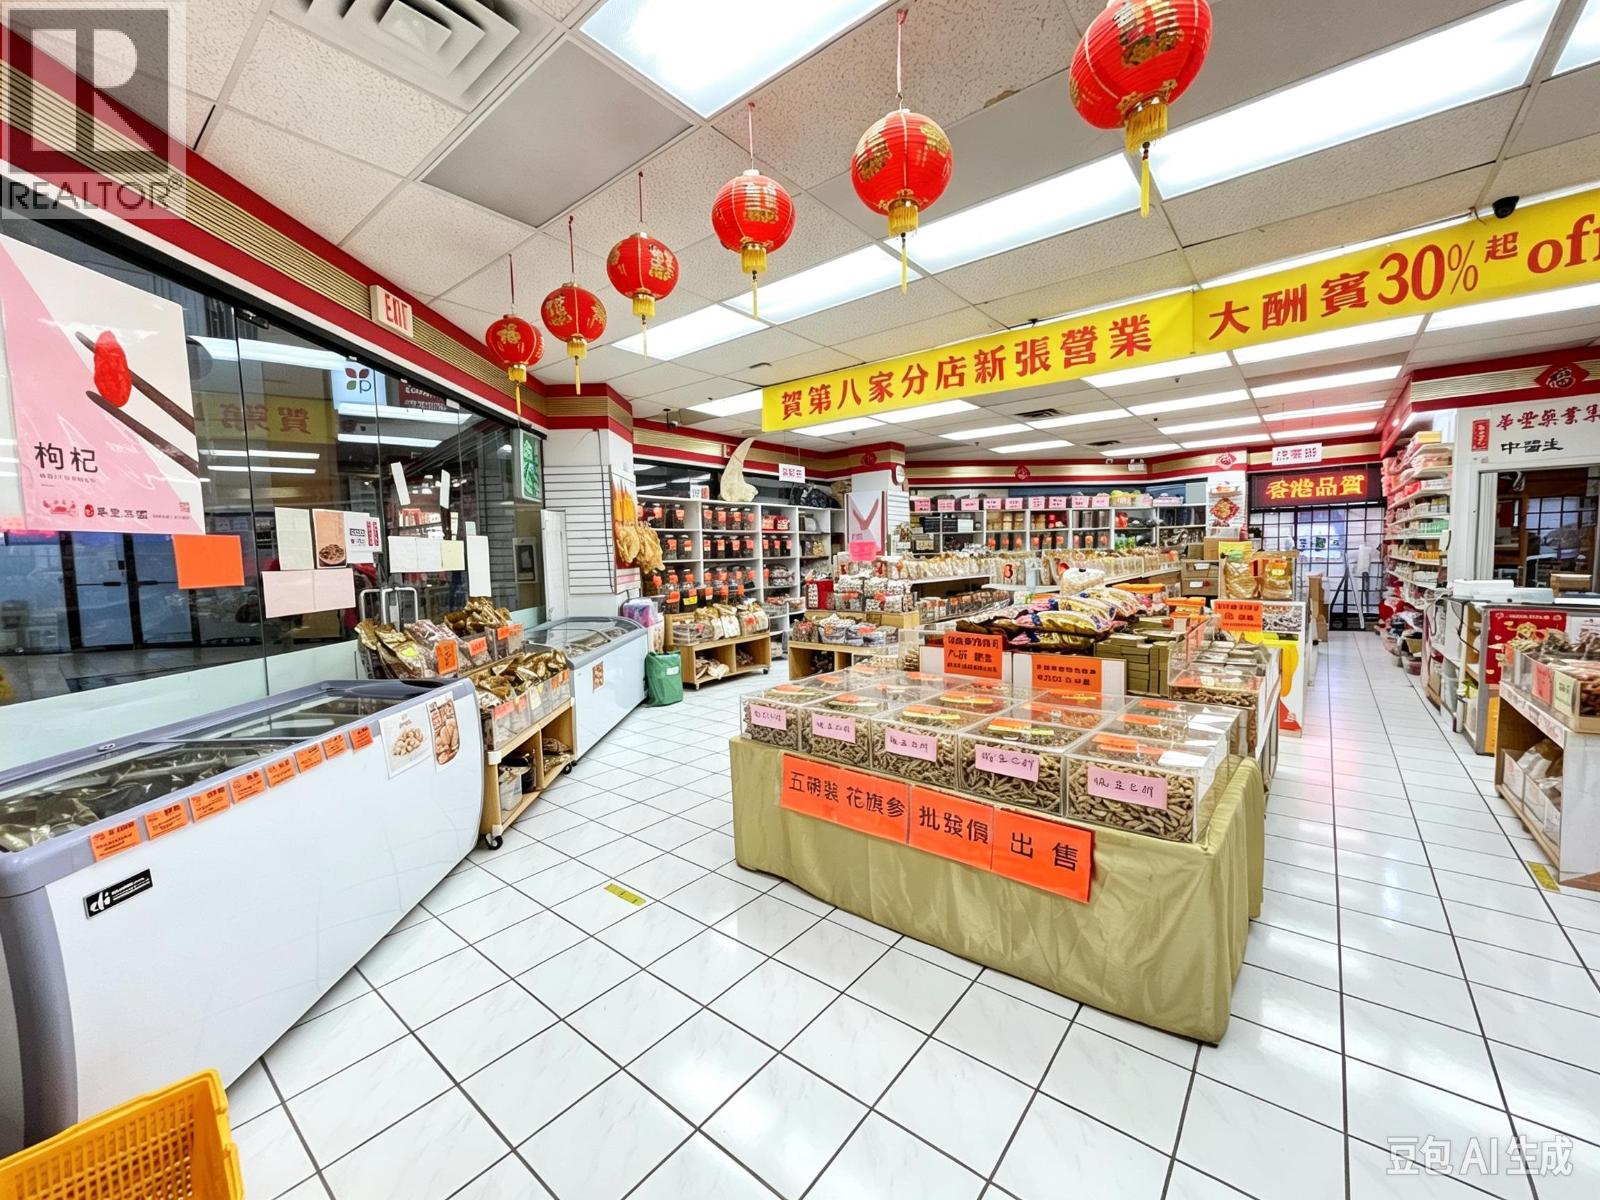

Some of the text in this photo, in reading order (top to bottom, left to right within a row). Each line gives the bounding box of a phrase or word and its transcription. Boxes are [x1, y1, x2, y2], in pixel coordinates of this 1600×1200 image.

[781, 313, 1152, 420] 賀第八家分店新張營業
[34, 442, 98, 474] 枸杞
